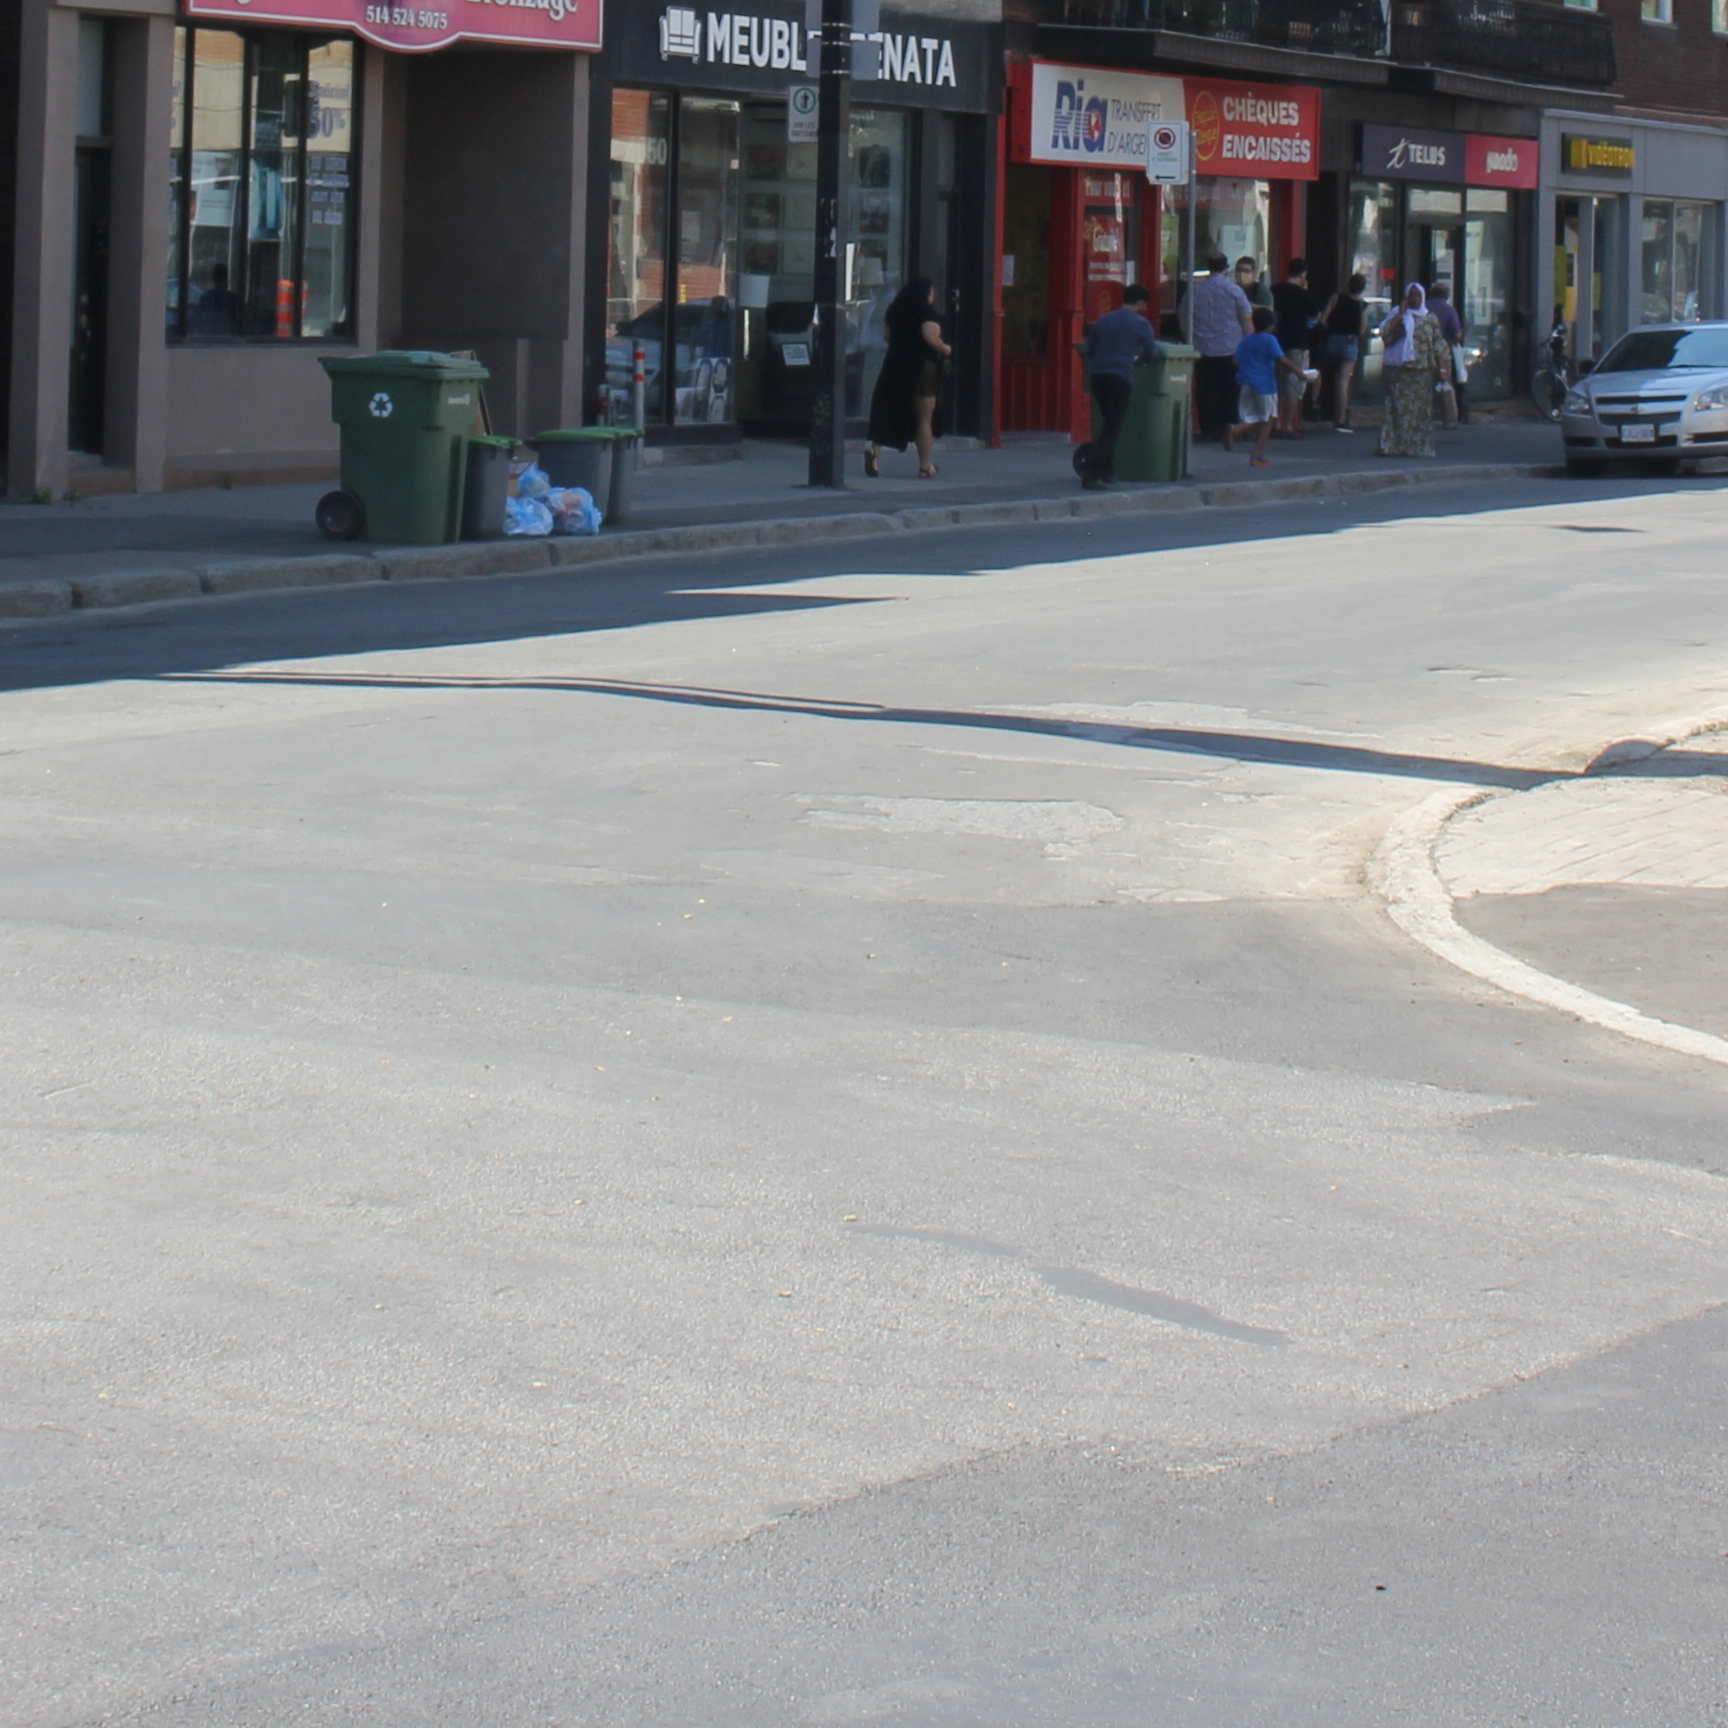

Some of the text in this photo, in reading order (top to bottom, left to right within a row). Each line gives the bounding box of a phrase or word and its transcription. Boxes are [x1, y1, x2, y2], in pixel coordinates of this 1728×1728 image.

[365, 5, 448, 30] 514 524 5075
[706, 11, 823, 72] MEUBL
[1051, 77, 1109, 153] Ria
[1222, 92, 1300, 127] CHÈQUES
[1107, 130, 1148, 156] D'ARGE
[1222, 132, 1312, 164] ENCAISSÉS
[1407, 143, 1446, 167] TELUS
